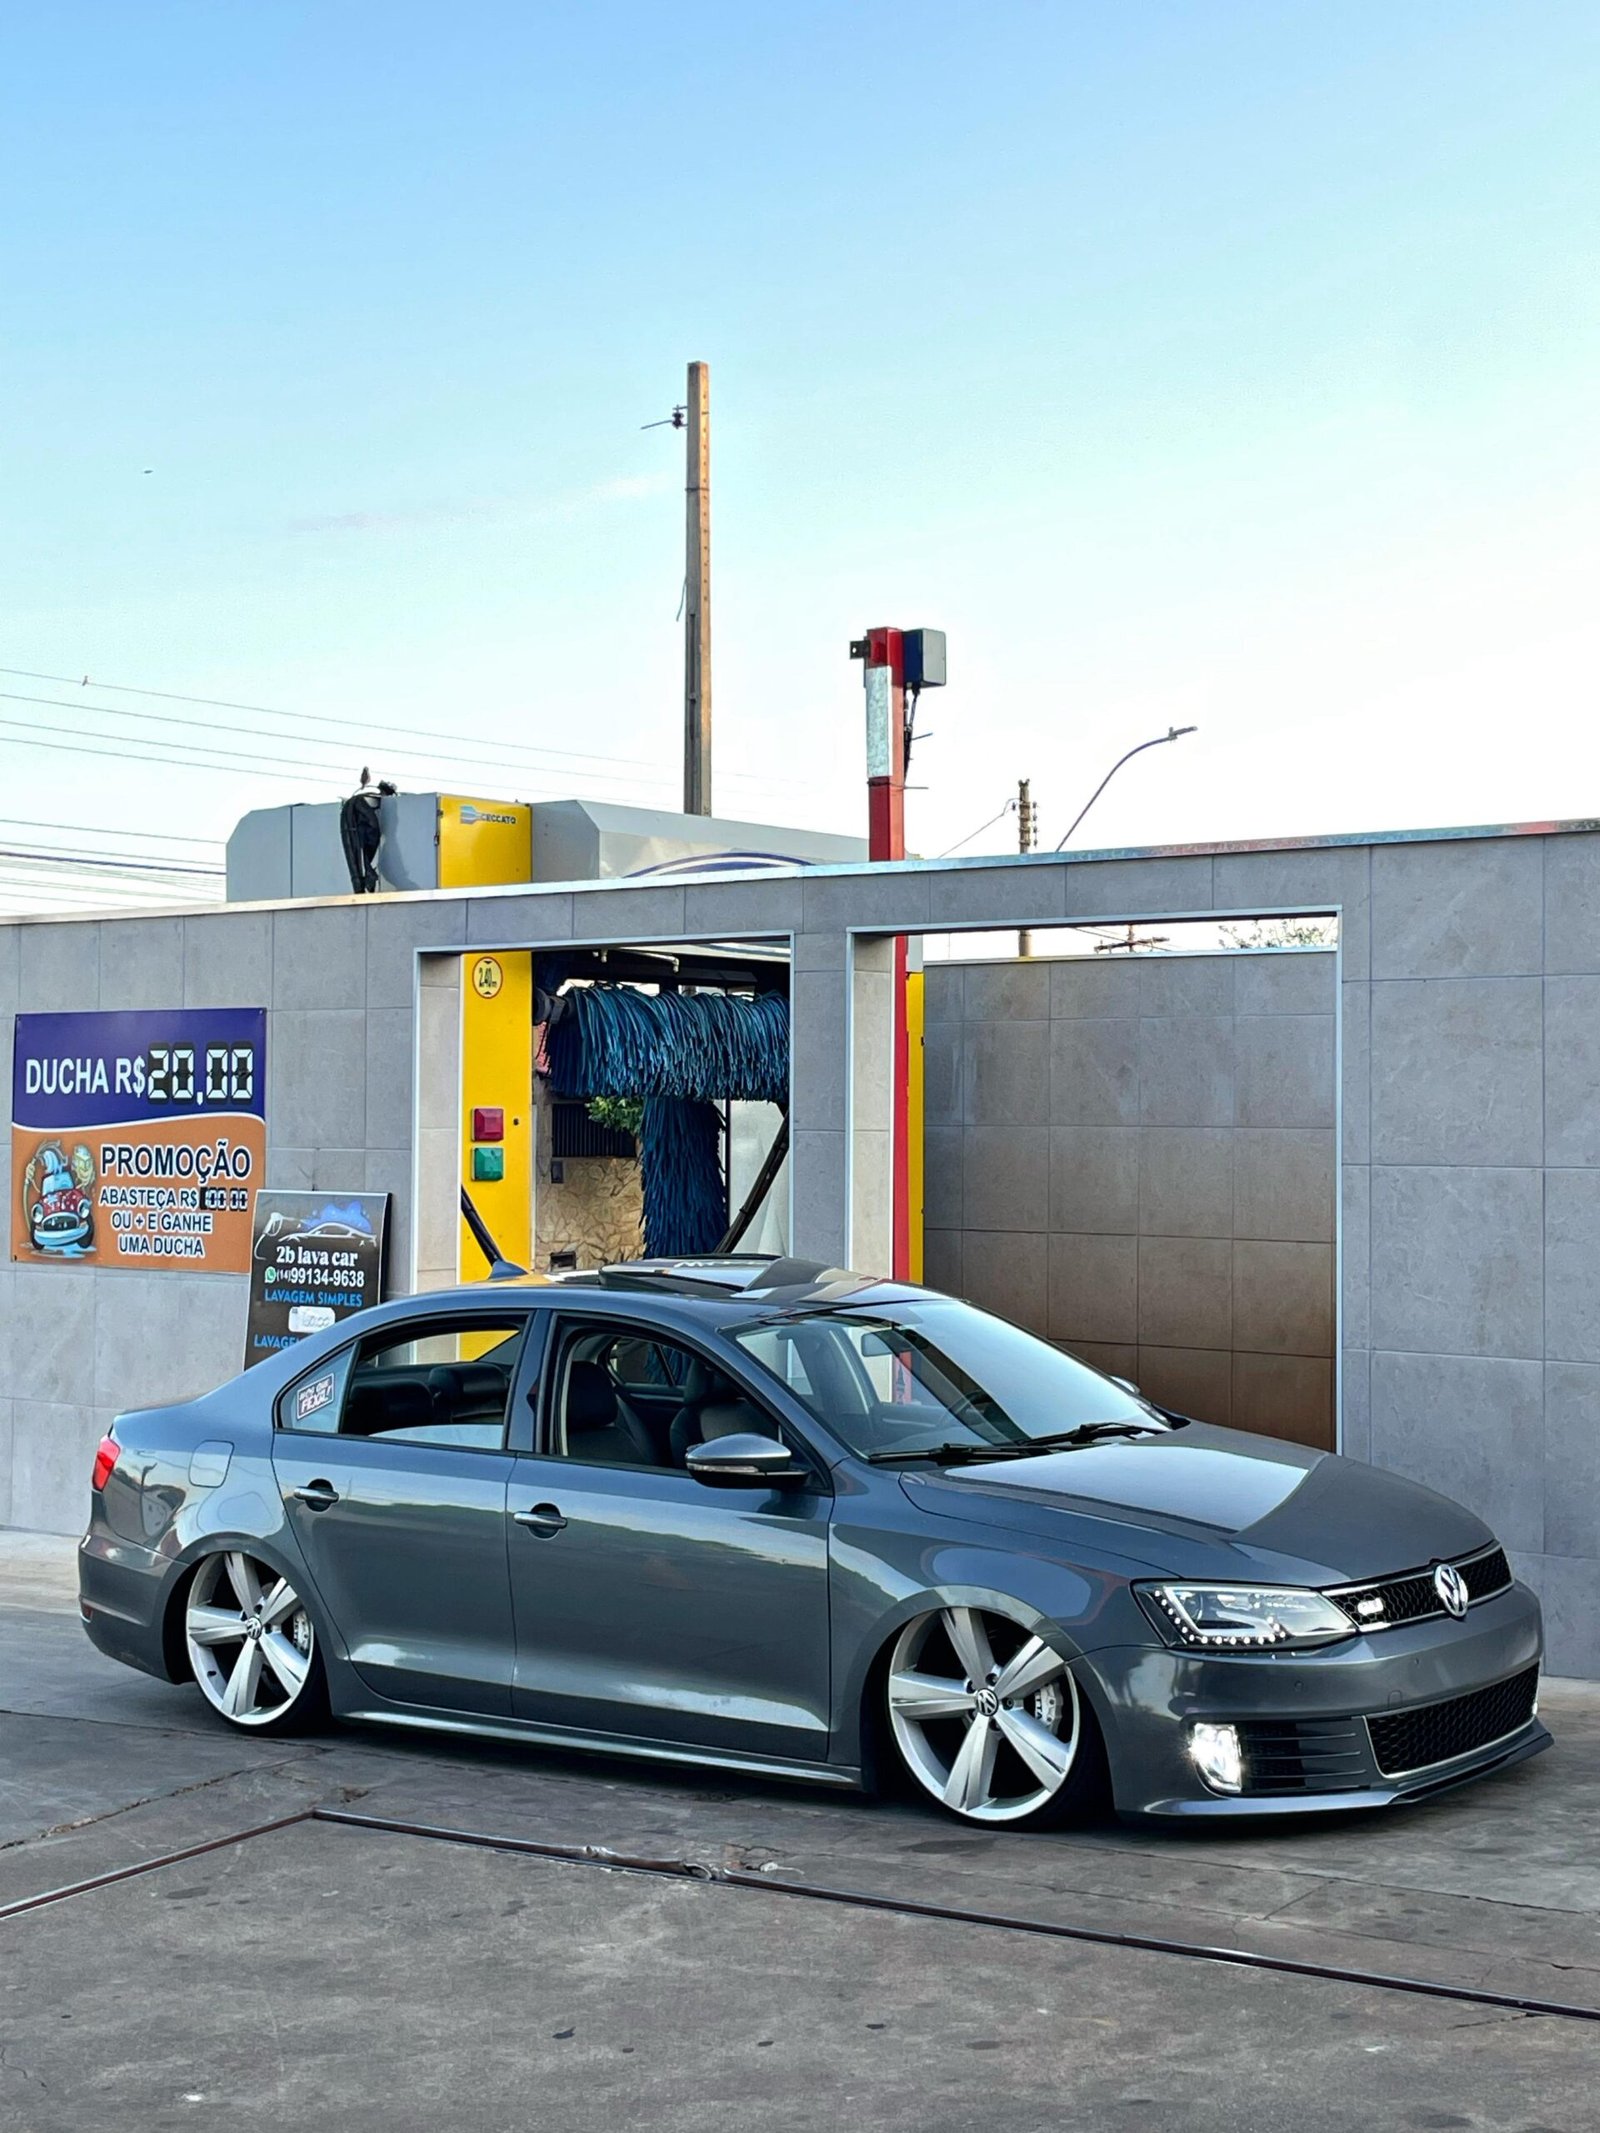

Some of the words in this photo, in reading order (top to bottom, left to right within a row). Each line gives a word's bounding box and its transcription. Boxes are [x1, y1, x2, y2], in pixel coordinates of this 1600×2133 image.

[480, 813, 517, 825] CECCATO
[26, 1058, 109, 1095] DUCHA
[101, 1140, 251, 1184] PROMOÇÃO
[100, 1188, 176, 1210] ABASTEÇA
[112, 1212, 131, 1229] OU
[136, 1217, 144, 1226] +
[148, 1213, 157, 1230] E
[161, 1214, 212, 1232] GANHE
[119, 1236, 150, 1253] UMA
[153, 1237, 204, 1256] DUCHA
[276, 1246, 295, 1264] 2b
[298, 1247, 329, 1265] lava
[332, 1251, 358, 1267] car
[265, 1289, 315, 1304] LAVAGEM
[318, 1292, 362, 1307] SIMPLES
[254, 1334, 300, 1350] LAVAGE
